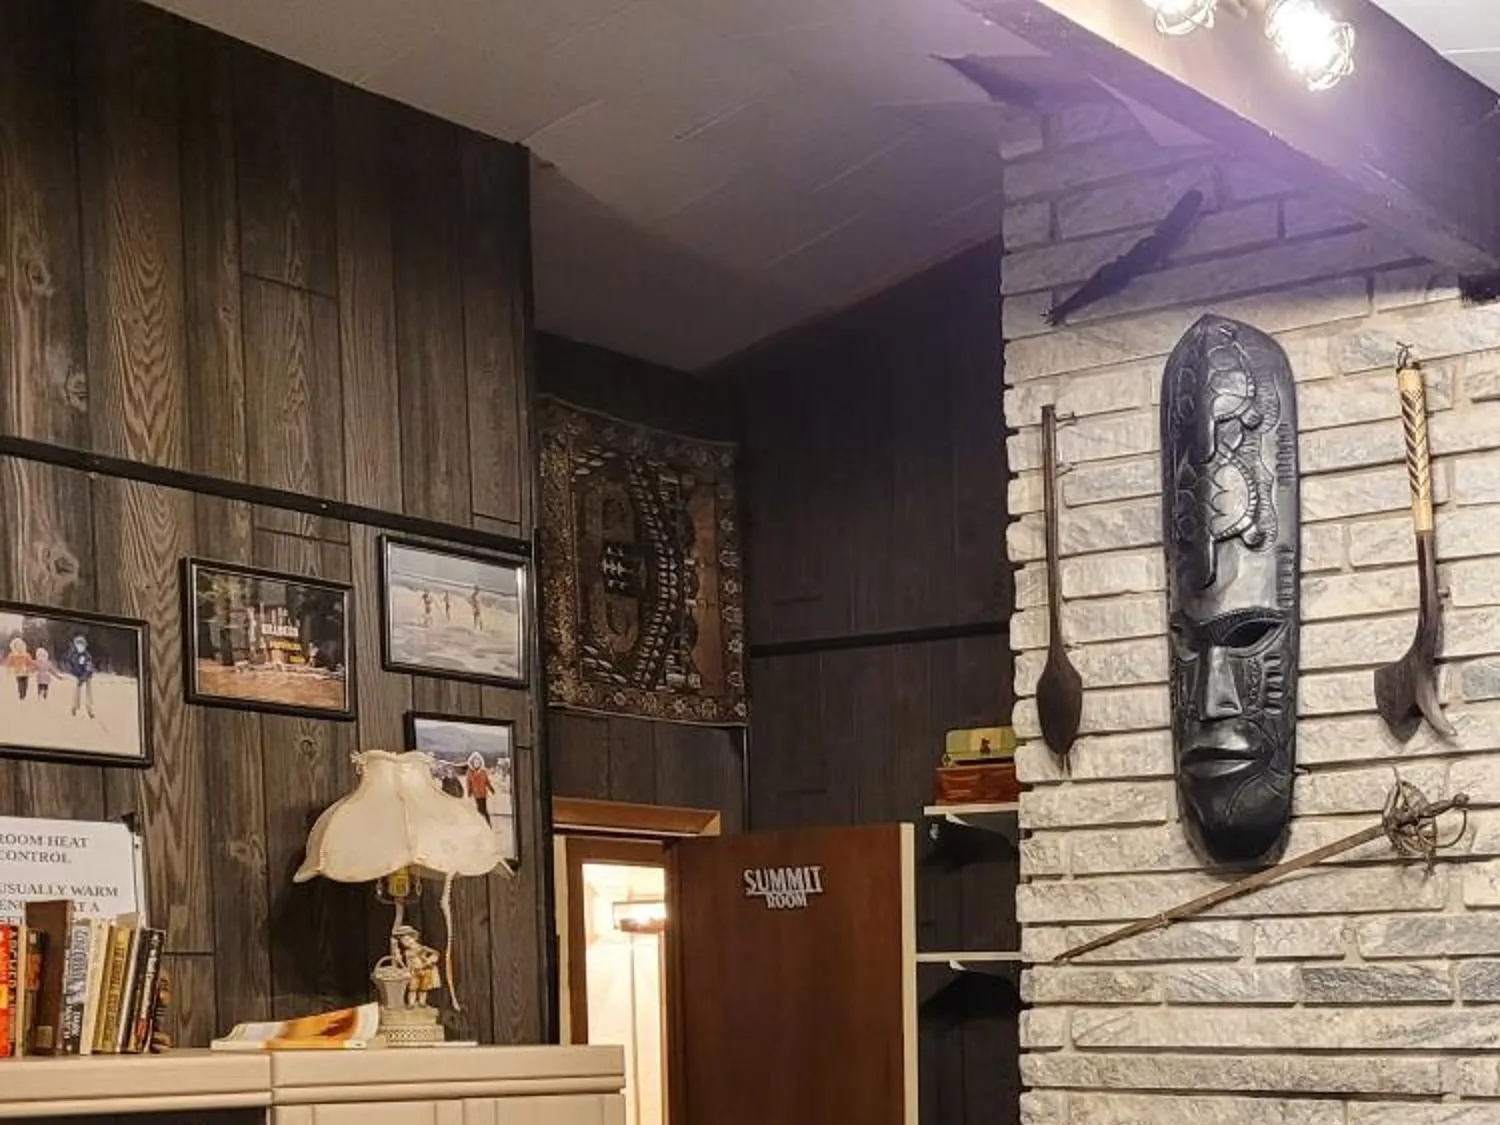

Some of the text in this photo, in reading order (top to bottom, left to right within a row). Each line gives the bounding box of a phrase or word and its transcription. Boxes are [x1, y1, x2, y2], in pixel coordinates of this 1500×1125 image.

[47, 835, 89, 849] HEAT
[743, 866, 824, 893] SUMMIT
[70, 885, 119, 897] WARM
[766, 891, 808, 909] ROOM
